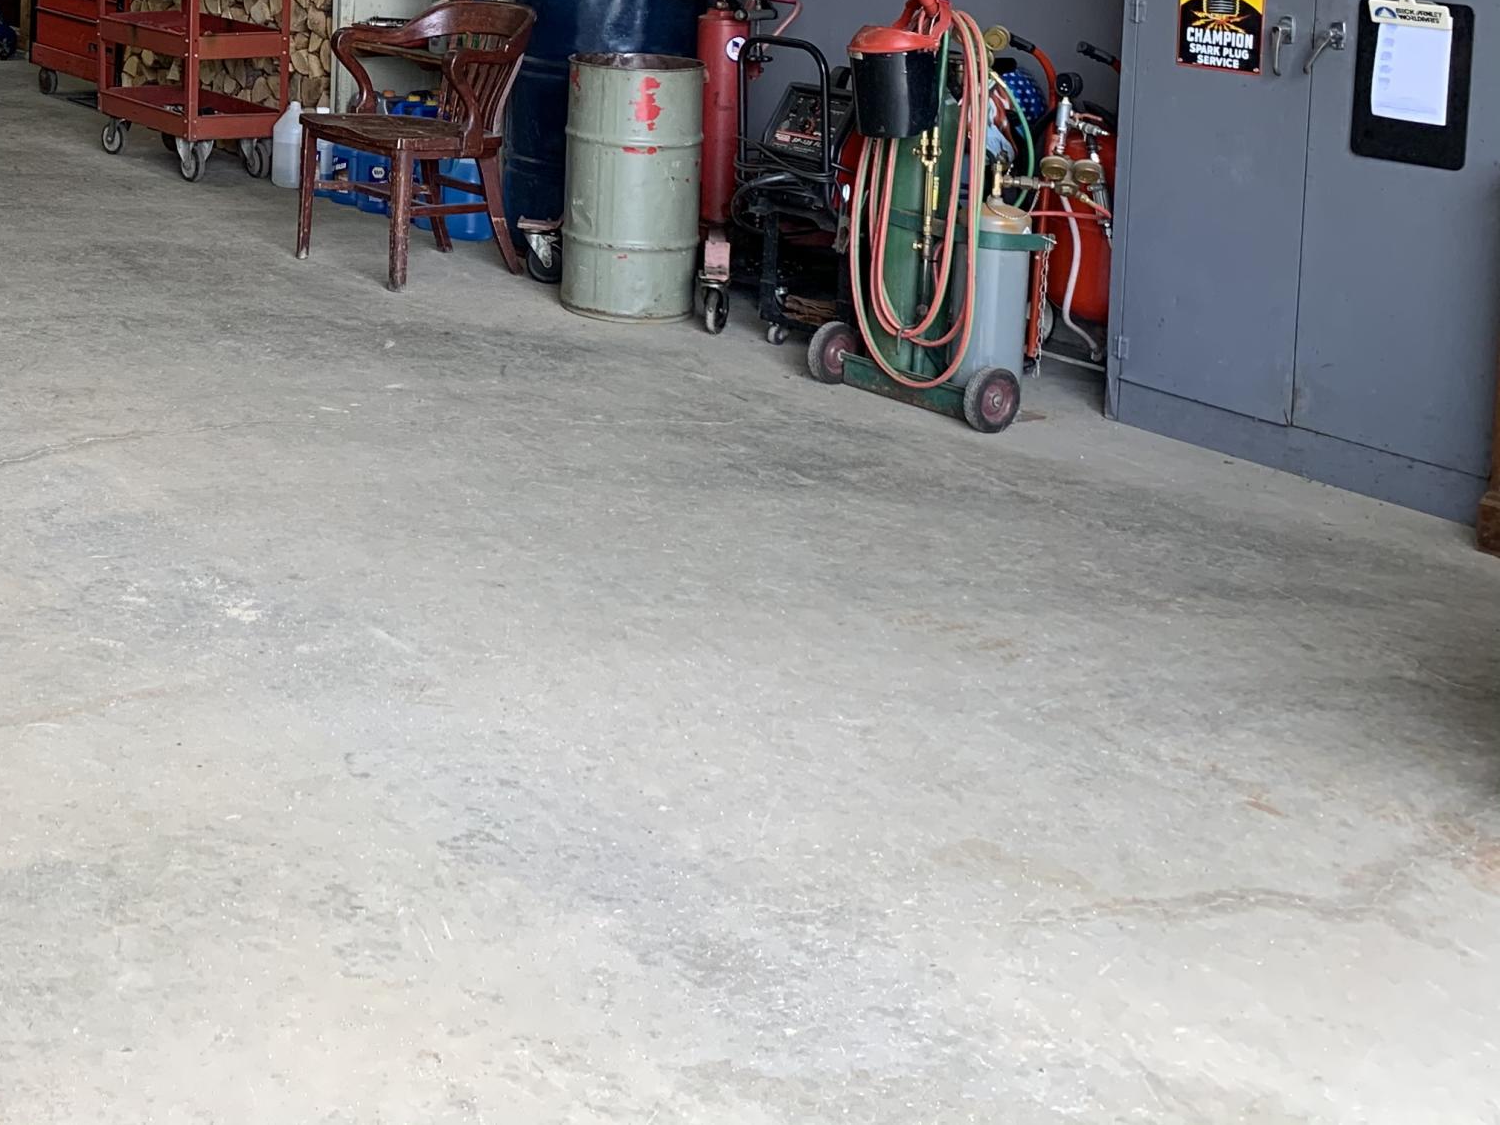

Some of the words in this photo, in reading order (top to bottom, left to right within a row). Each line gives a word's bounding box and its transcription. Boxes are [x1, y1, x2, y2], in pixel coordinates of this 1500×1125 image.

[1186, 26, 1254, 49] CHAMPION
[1189, 42, 1220, 56] SPARK
[1222, 47, 1249, 60] PLUG
[1197, 54, 1240, 69] SERVICE
